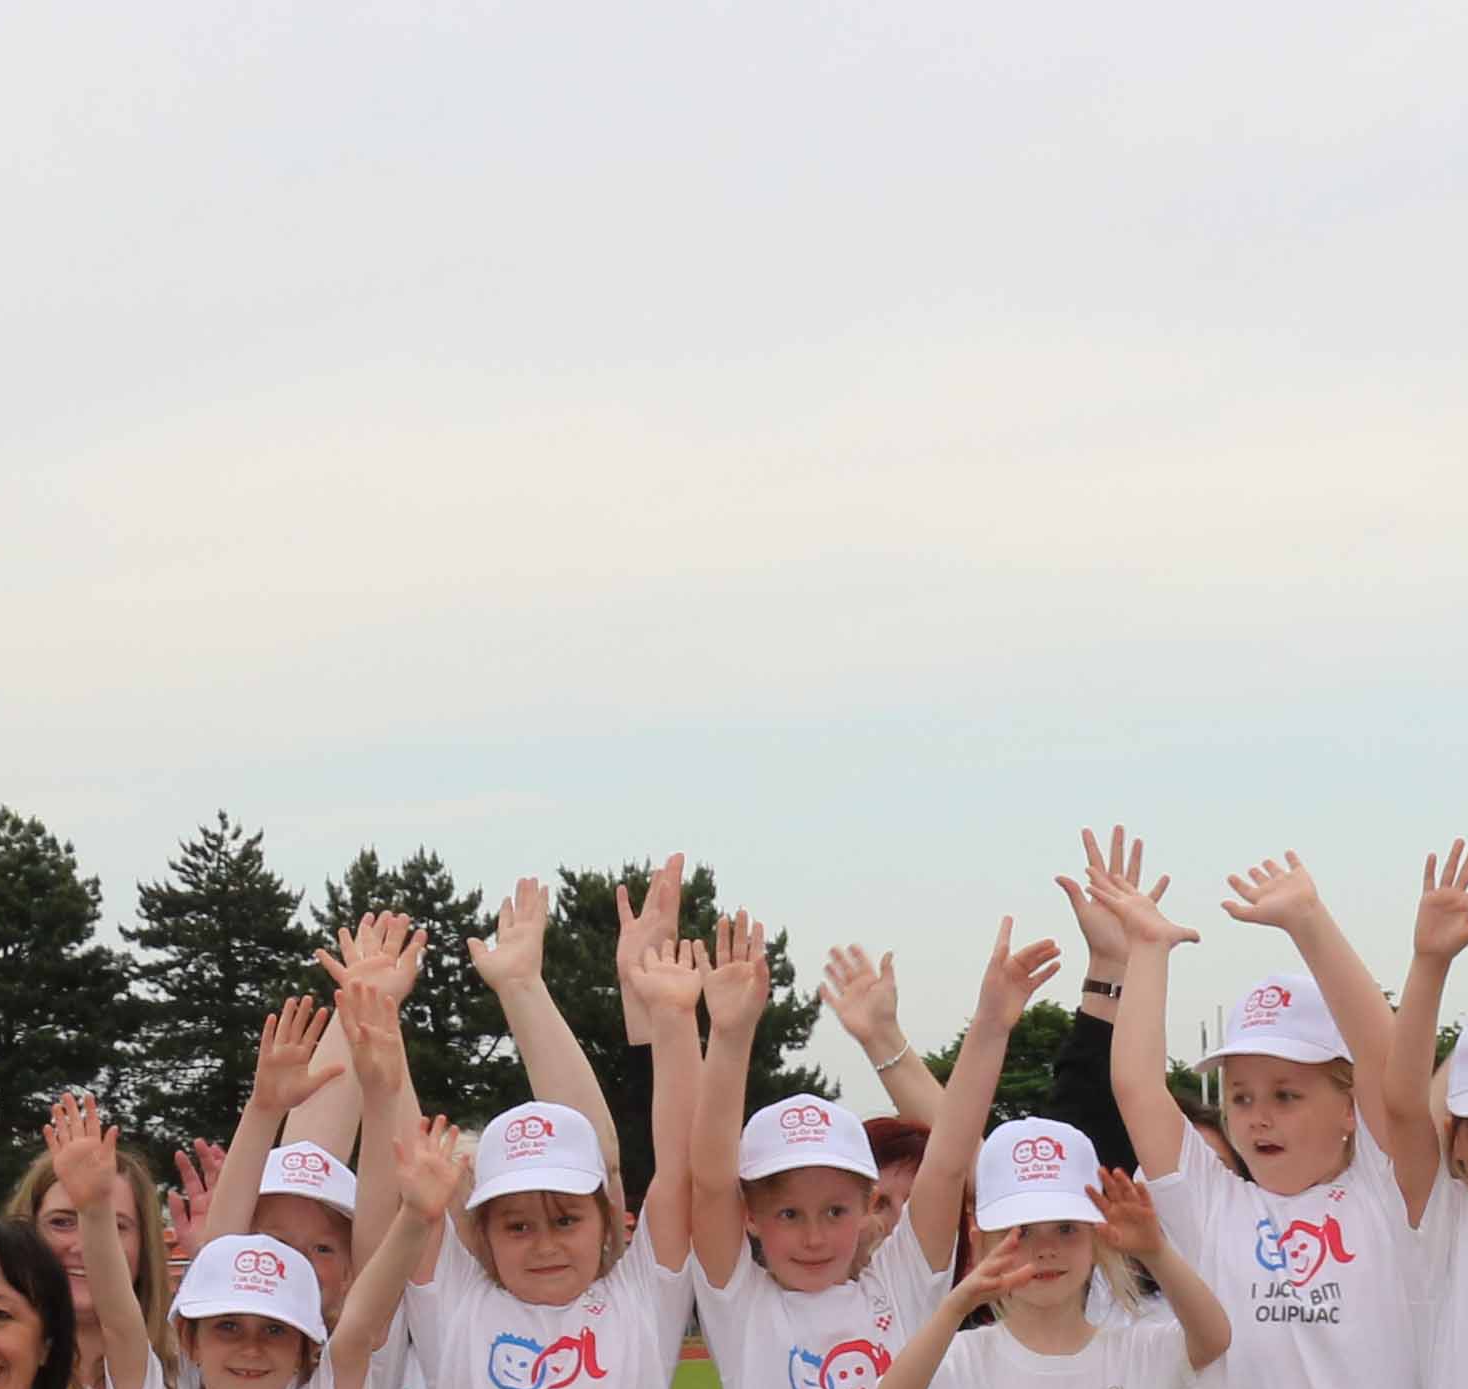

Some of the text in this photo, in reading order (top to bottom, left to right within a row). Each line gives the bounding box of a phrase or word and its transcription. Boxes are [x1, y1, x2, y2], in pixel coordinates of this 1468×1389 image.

[1251, 1282, 1257, 1300] I
[1309, 1282, 1341, 1306] BITI
[1255, 1305, 1341, 1325] OLIPIJAC
